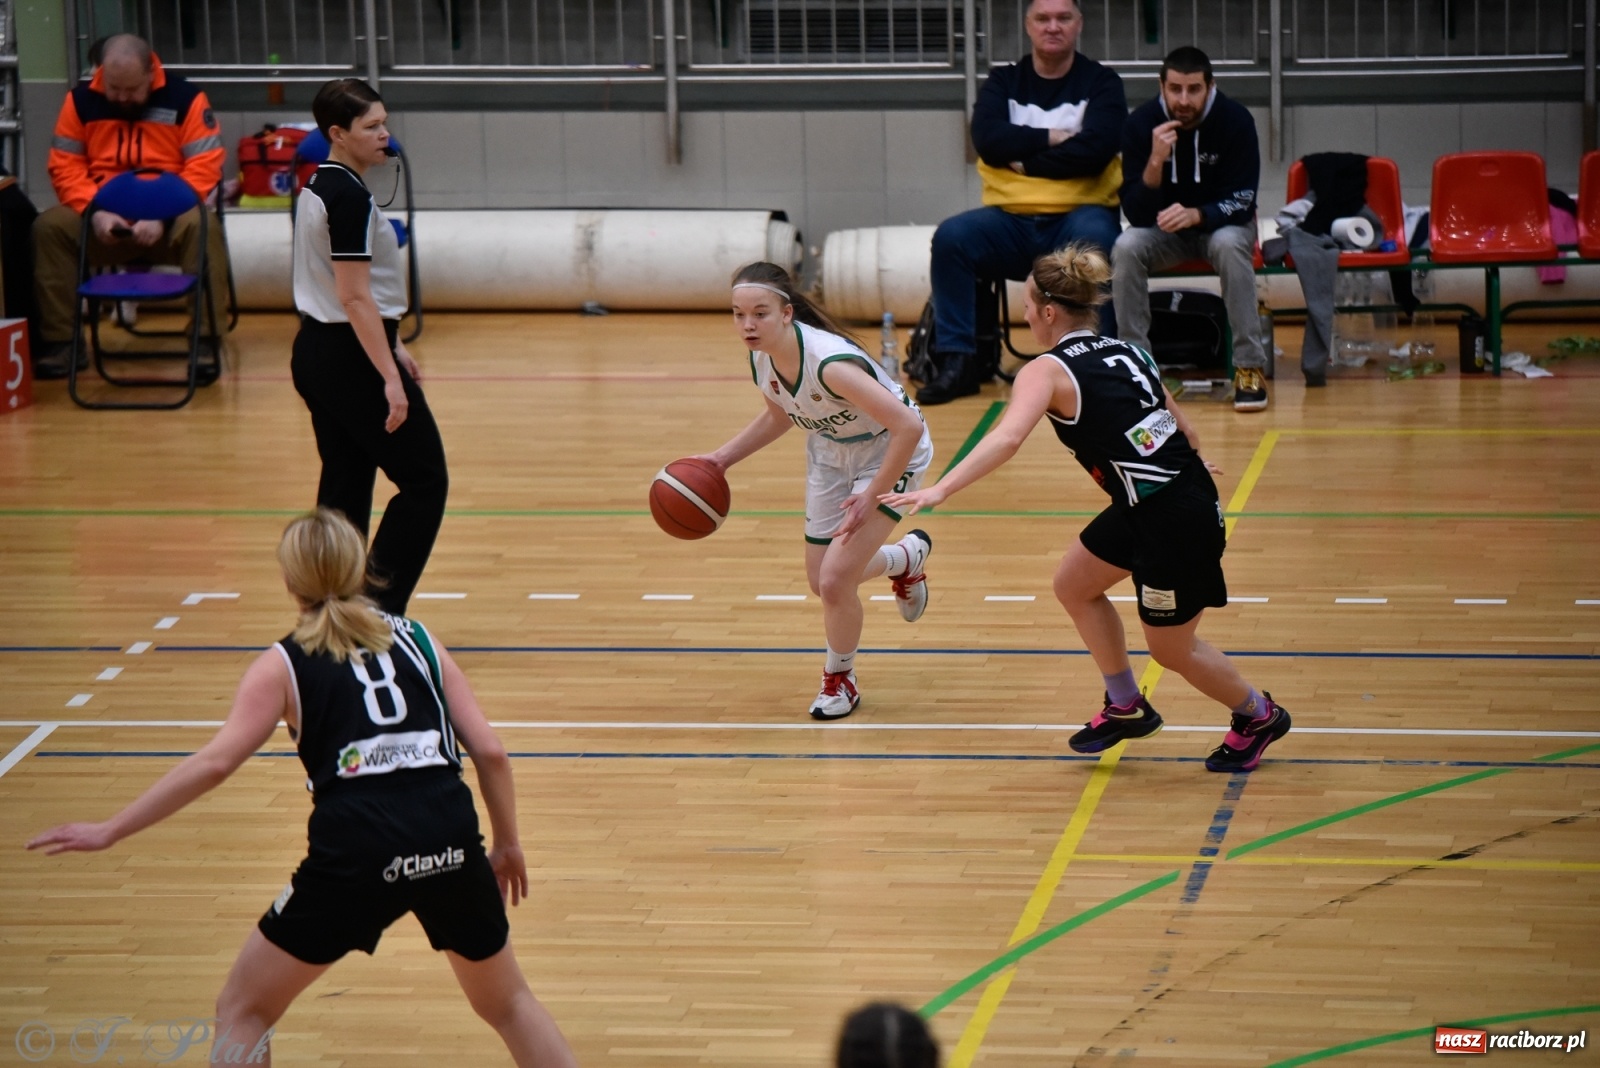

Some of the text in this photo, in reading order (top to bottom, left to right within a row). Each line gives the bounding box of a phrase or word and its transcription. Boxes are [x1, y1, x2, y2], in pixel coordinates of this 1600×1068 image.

[6, 329, 24, 391] 5
[350, 647, 408, 726] 8
[402, 846, 465, 876] Clavis
